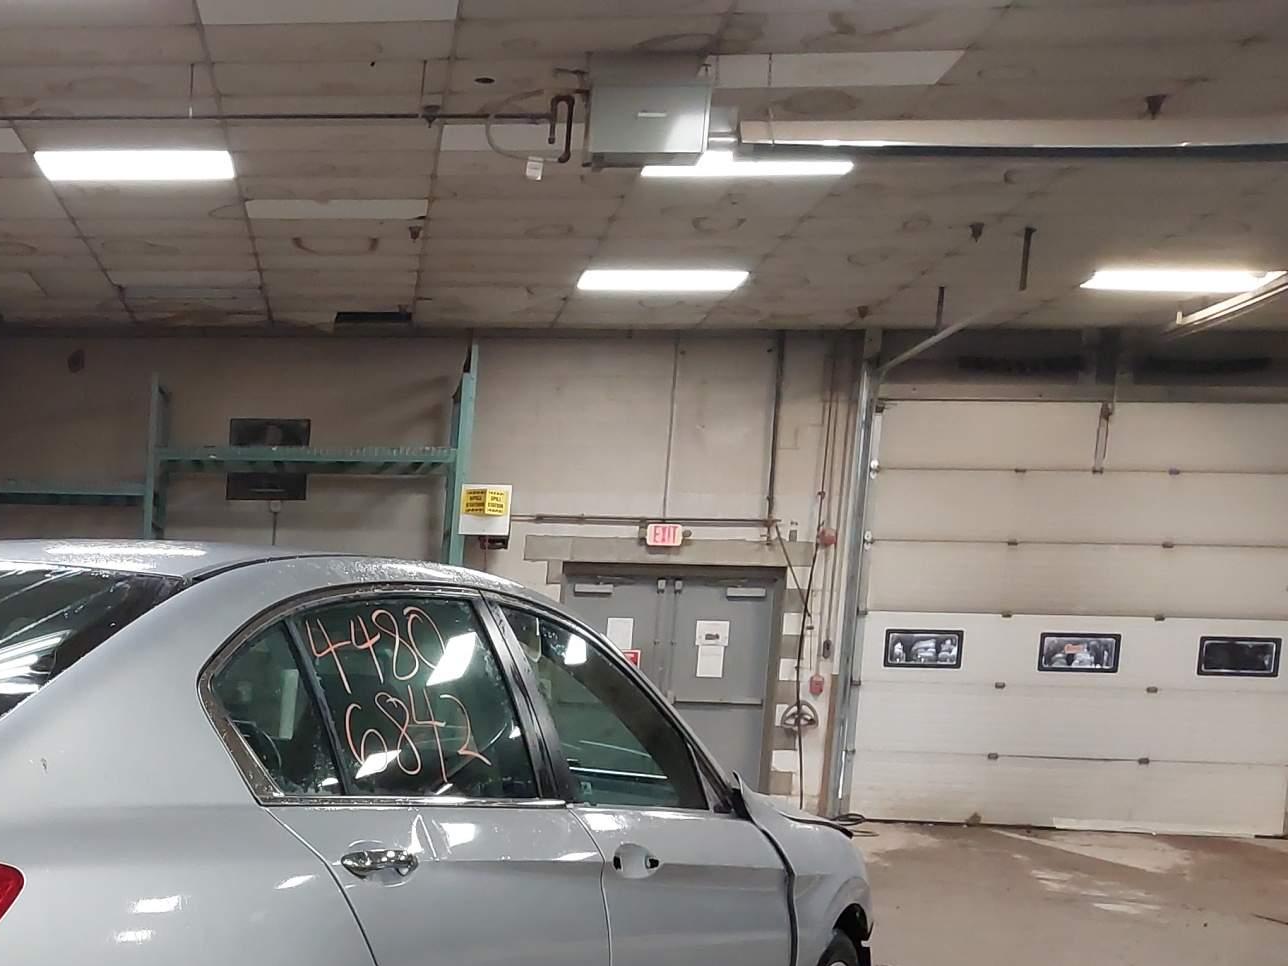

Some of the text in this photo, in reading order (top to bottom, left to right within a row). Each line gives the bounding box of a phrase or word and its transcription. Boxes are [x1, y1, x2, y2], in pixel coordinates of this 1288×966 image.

[653, 525, 679, 544] EXIT
[305, 606, 446, 695] 4480
[345, 684, 492, 783] 6842
